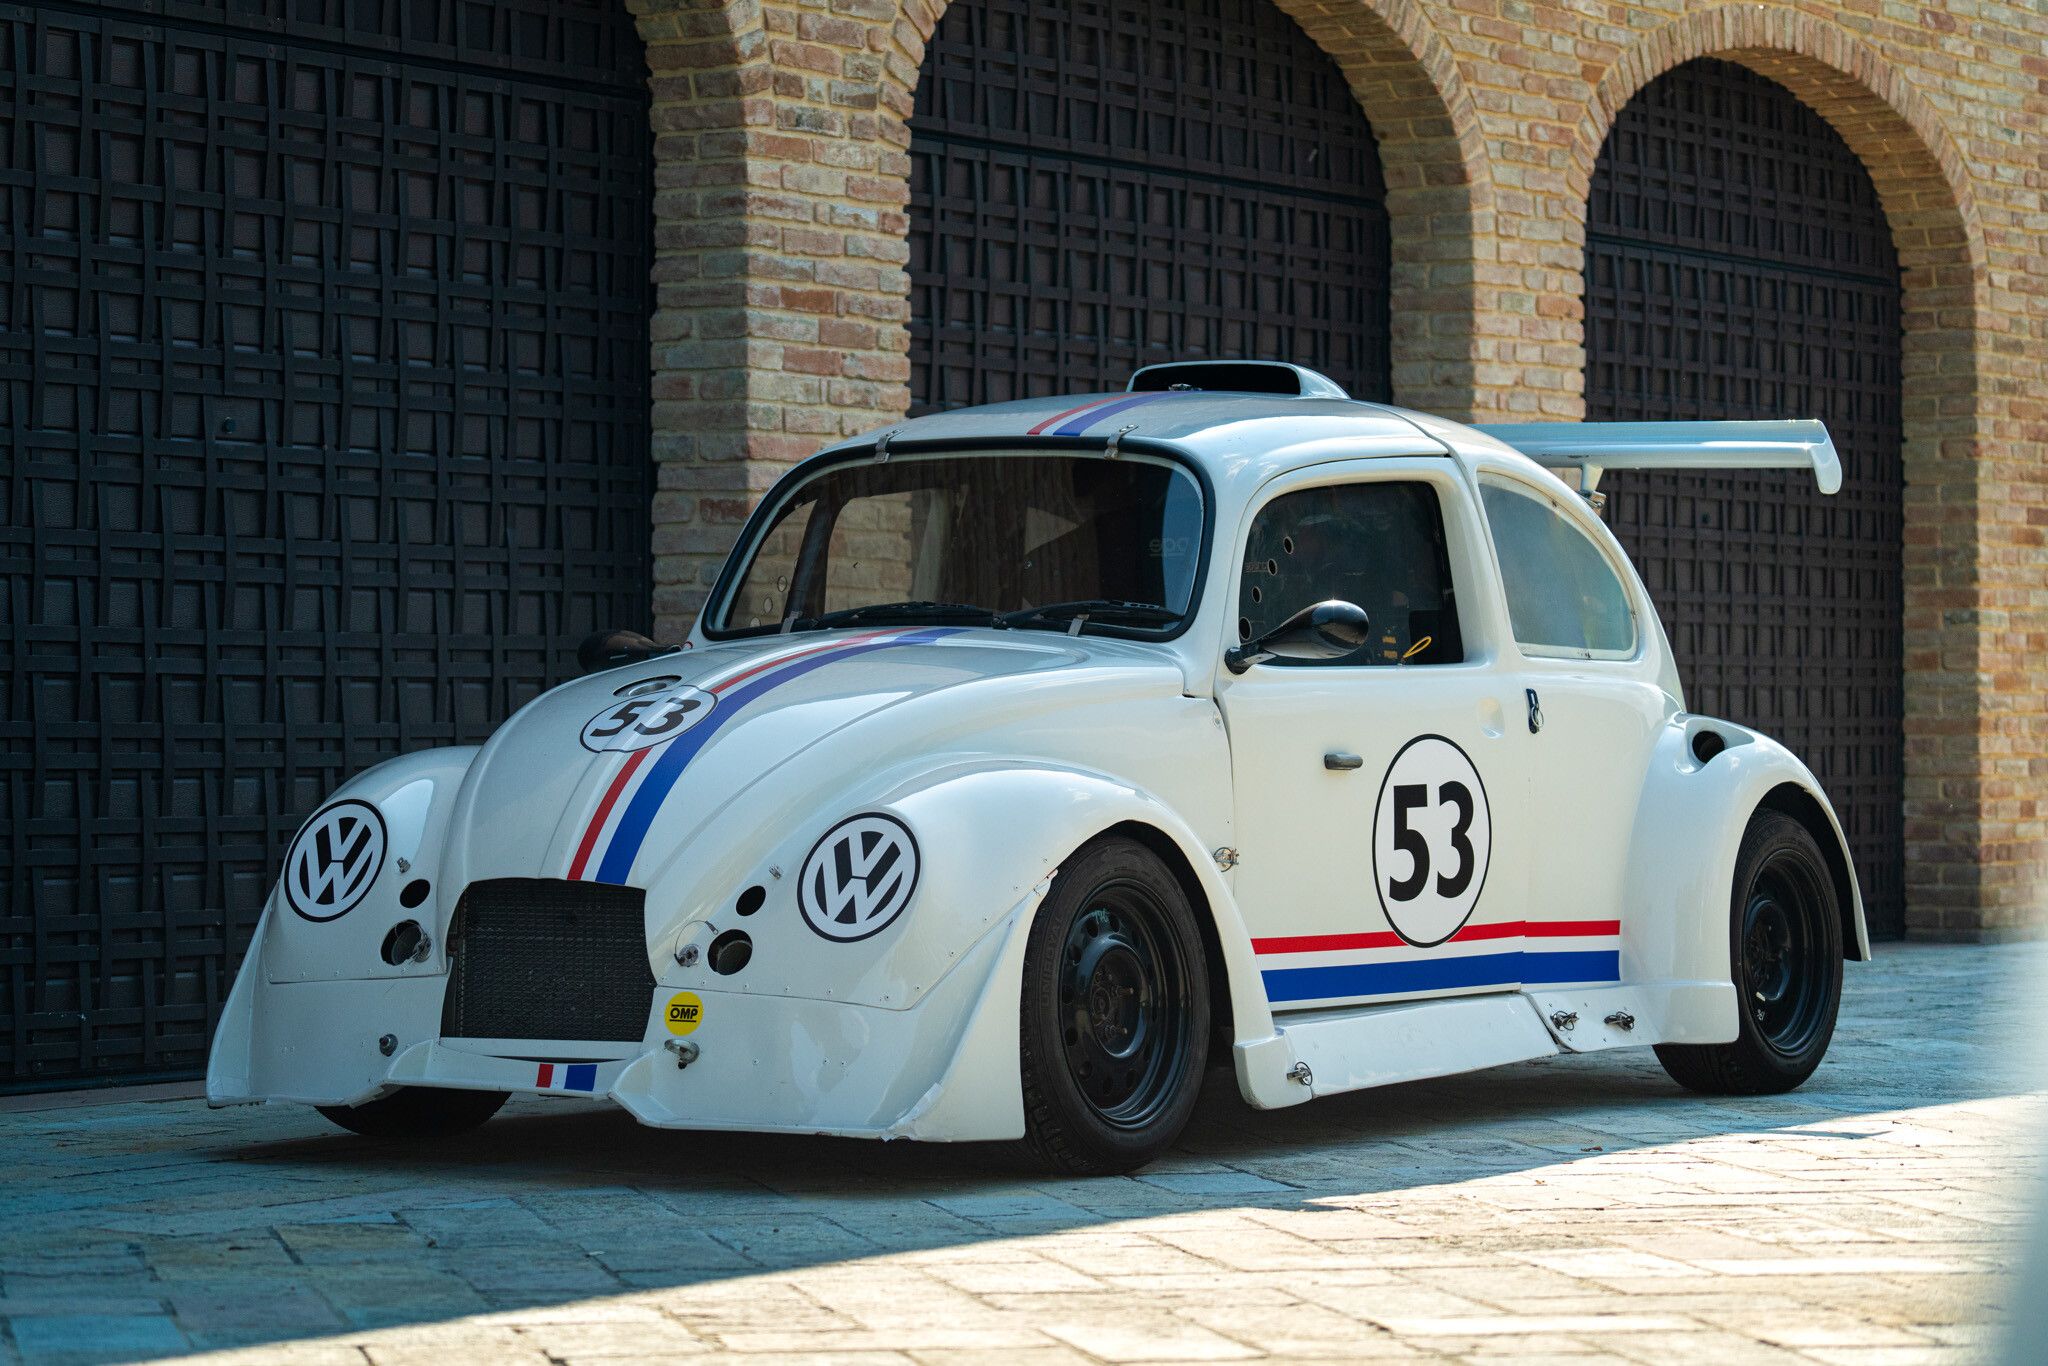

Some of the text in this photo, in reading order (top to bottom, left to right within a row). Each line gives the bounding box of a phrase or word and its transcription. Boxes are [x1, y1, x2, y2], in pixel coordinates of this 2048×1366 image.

[590, 697, 701, 736] 53
[293, 809, 379, 911] VW
[807, 821, 912, 934] VW
[1389, 780, 1474, 902] 53
[670, 1007, 698, 1020] OMP
